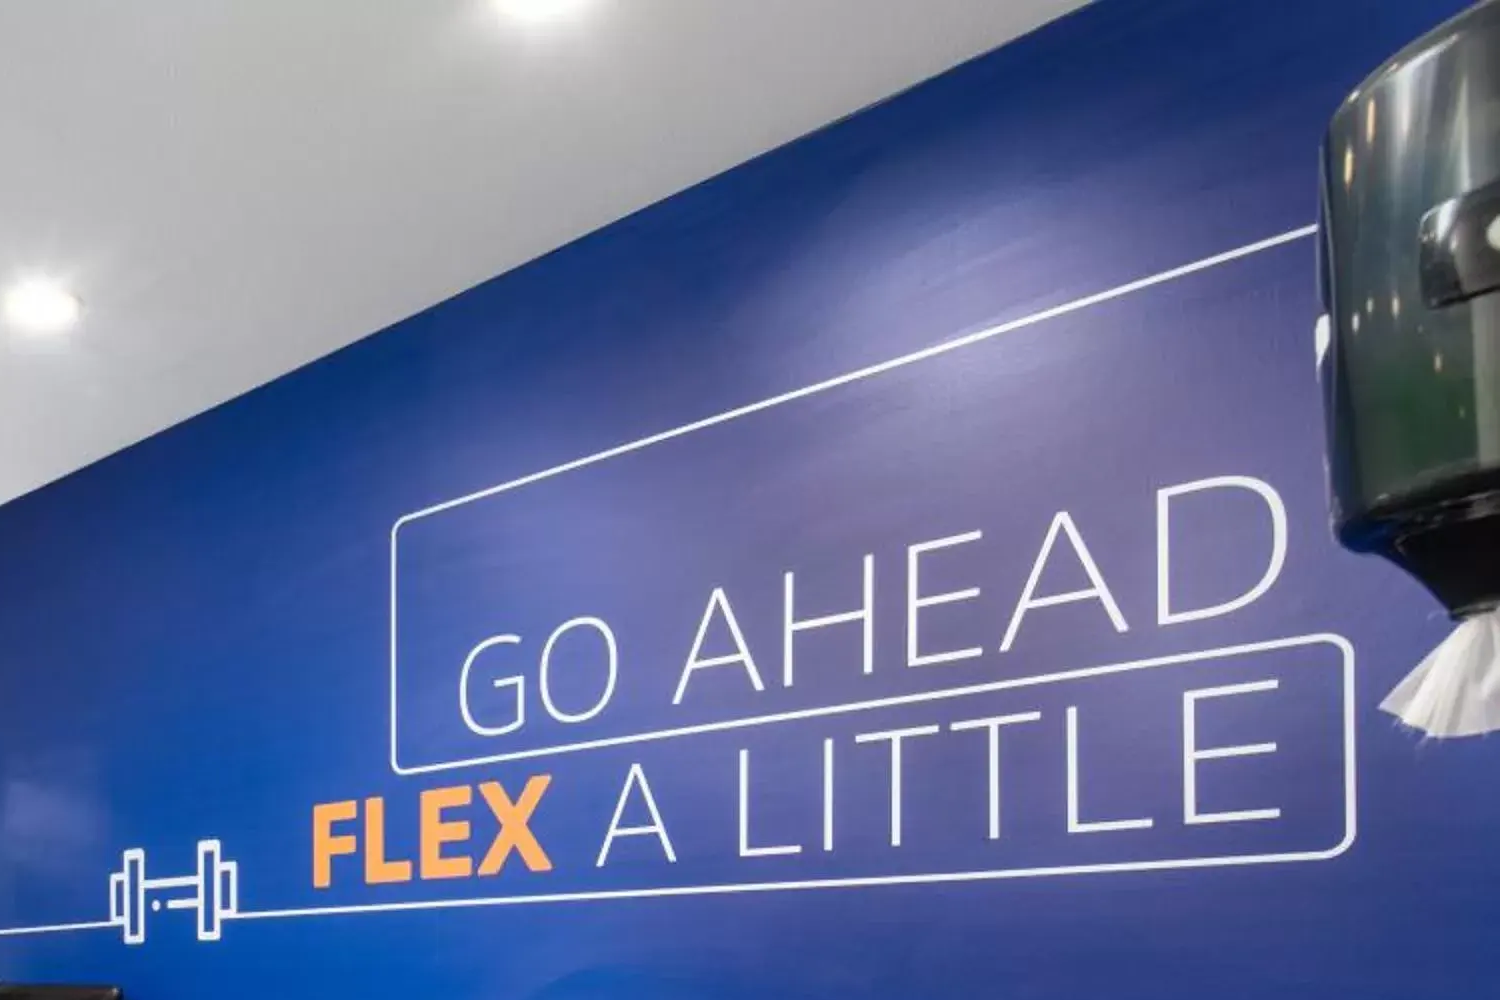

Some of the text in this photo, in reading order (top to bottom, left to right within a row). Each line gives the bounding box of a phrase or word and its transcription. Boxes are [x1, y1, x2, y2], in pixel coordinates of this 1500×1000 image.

[459, 475, 1288, 736] GO AHEAD
[313, 679, 1281, 888] FLEX A LITTLE
